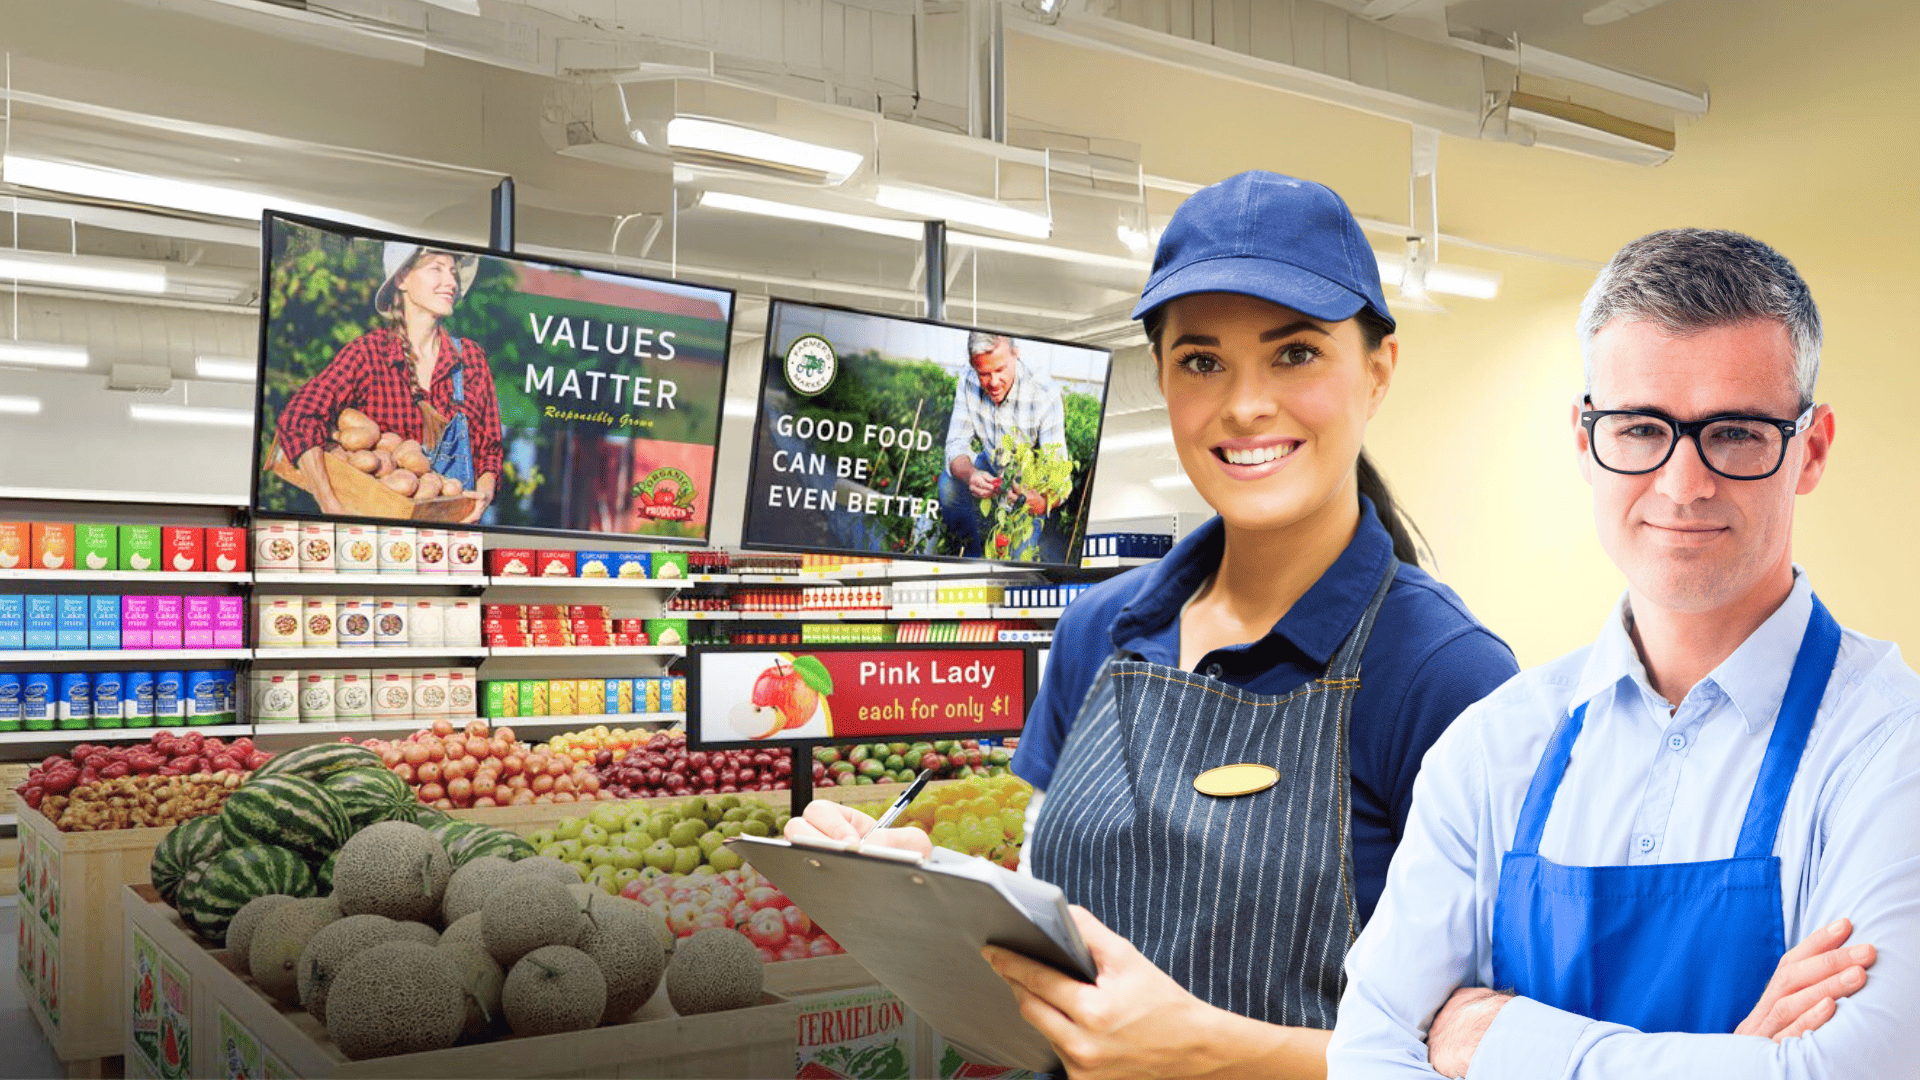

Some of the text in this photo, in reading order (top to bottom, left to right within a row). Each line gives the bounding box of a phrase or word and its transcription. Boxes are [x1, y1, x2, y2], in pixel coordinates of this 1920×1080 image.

[529, 312, 677, 361] VALUES
[525, 363, 678, 410] MATTER
[793, 373, 827, 388] MARKET
[543, 405, 655, 428] Responsibly Grown
[776, 414, 933, 452] GOOD FOOD
[772, 450, 869, 480] CAN BE
[768, 485, 940, 520] EVEN BETTER
[859, 659, 996, 689] Pink Lady
[858, 693, 1010, 724] each for only $1
